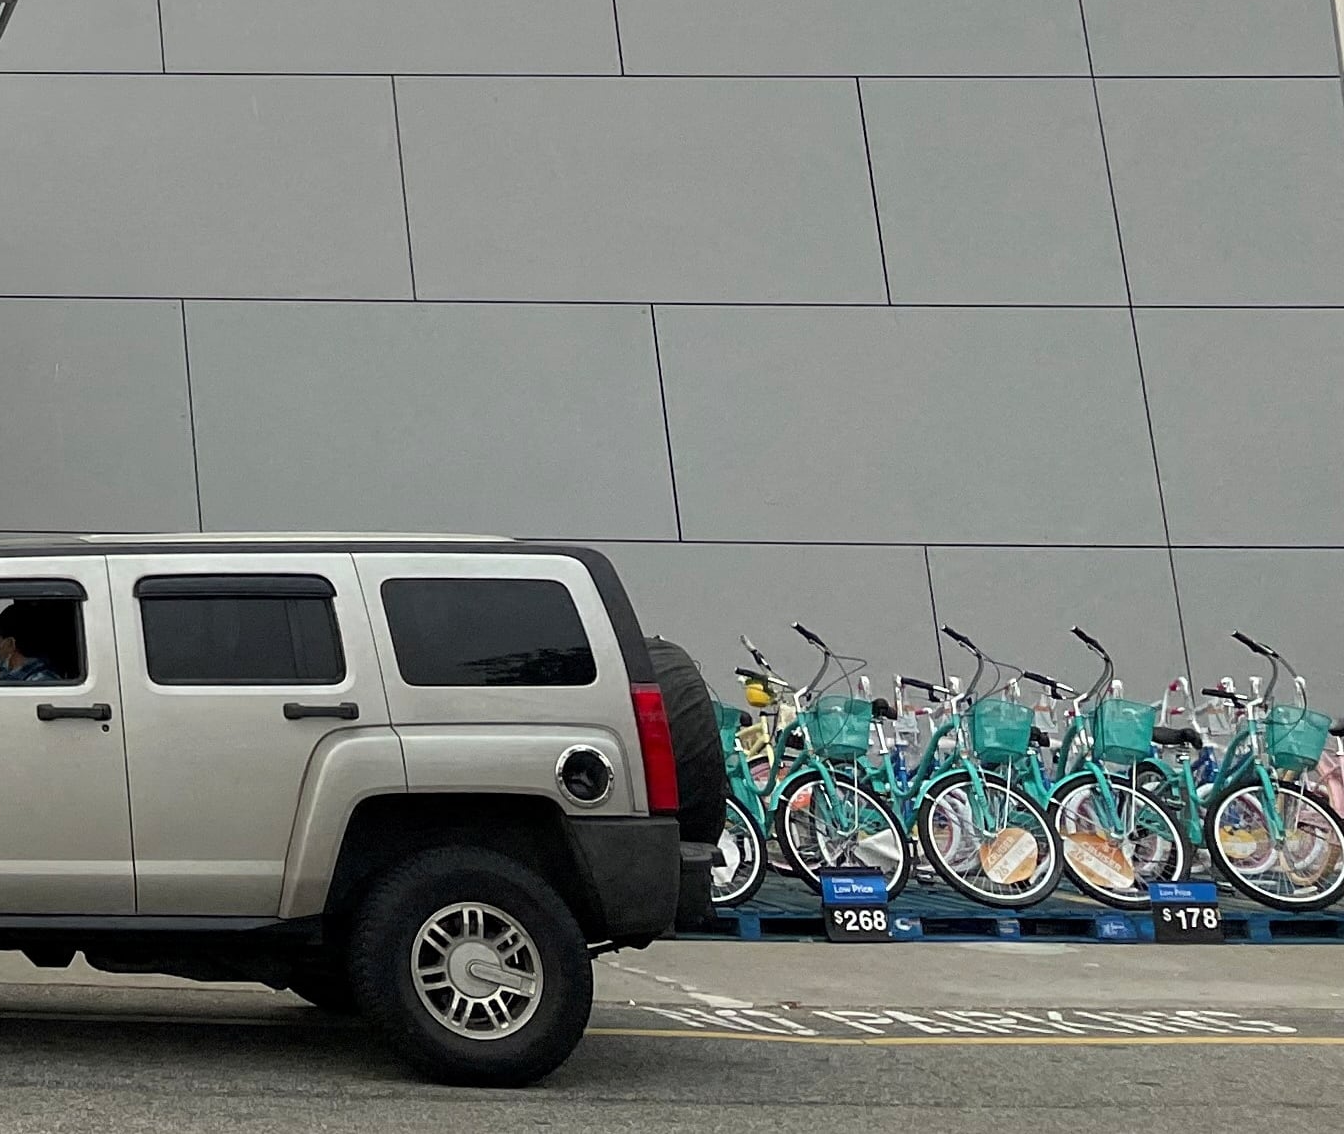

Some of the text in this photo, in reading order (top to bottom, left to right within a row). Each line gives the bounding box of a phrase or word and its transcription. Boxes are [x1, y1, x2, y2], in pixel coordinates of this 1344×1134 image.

[833, 884, 874, 894] Low Price
[833, 910, 887, 931] $268
[641, 1007, 1297, 1036] NO PARKING
